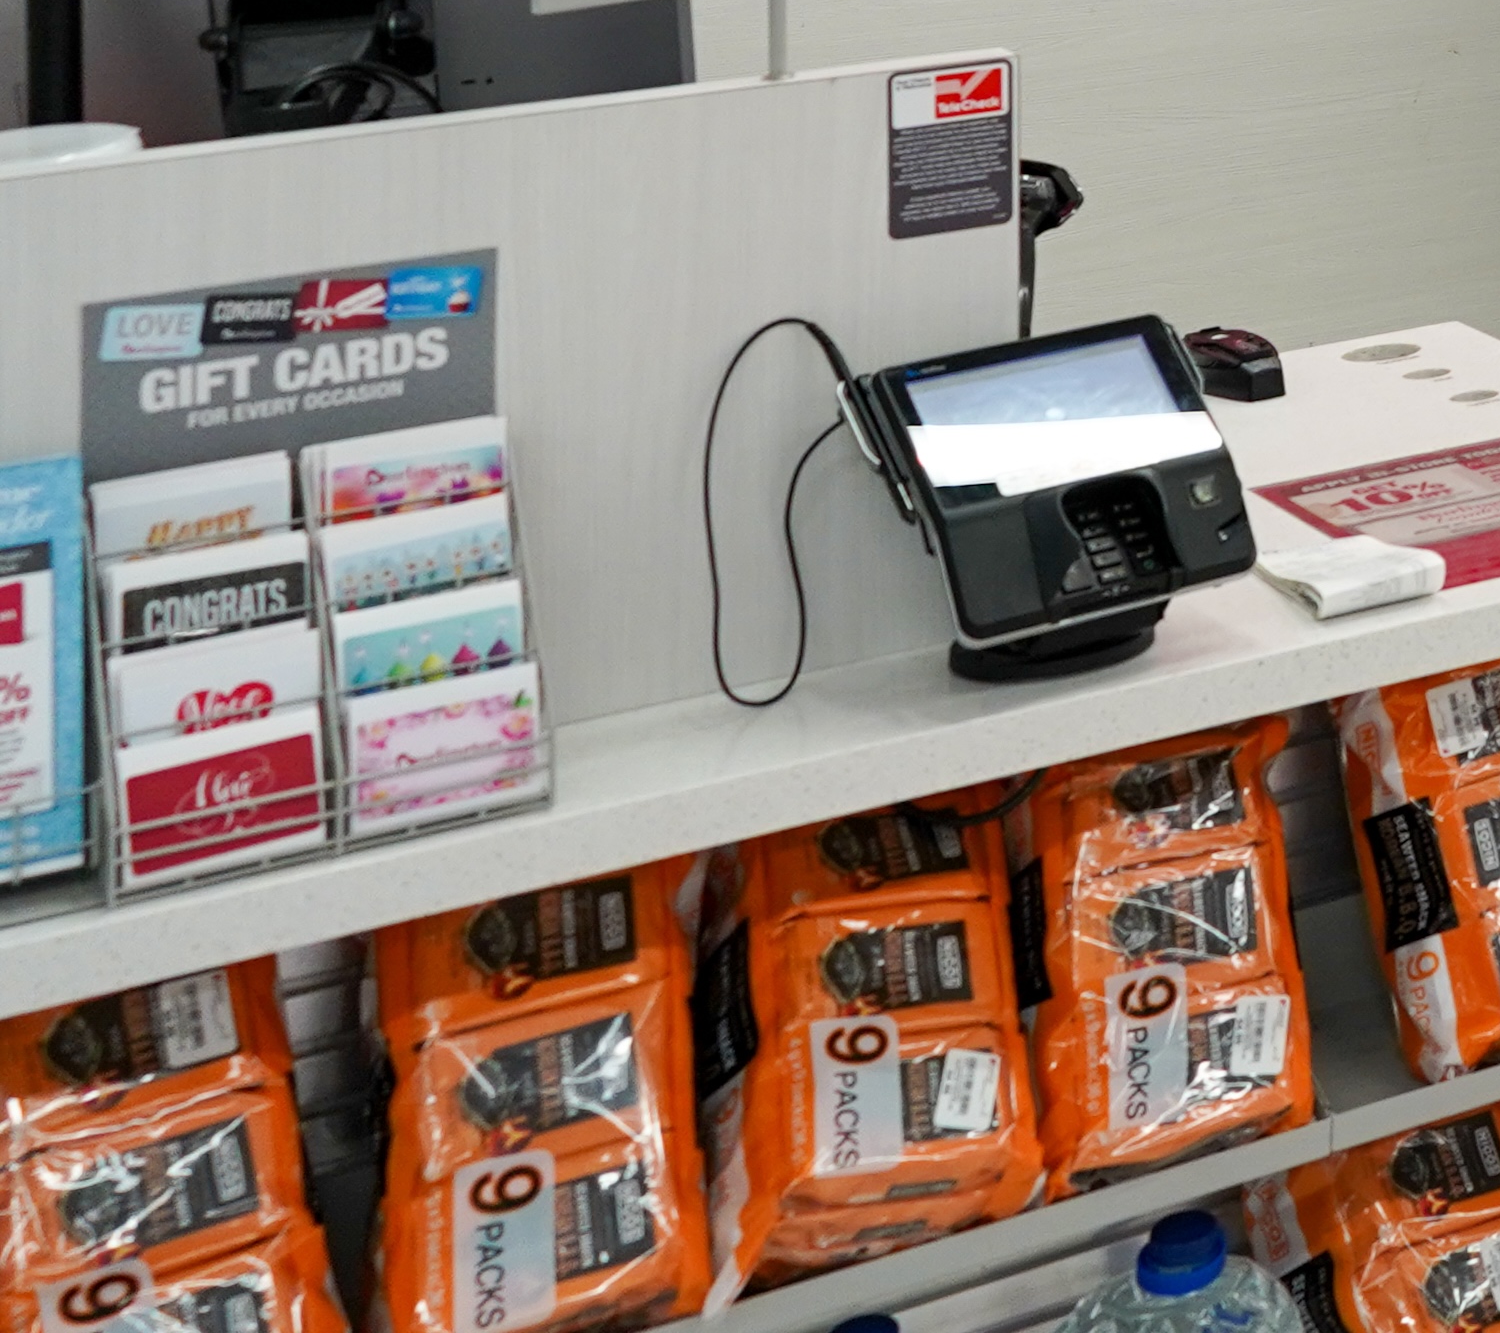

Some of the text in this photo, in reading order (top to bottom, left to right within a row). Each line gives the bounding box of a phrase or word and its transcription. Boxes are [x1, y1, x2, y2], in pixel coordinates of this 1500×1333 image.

[117, 310, 195, 343] LOVE
[138, 327, 451, 414] GIFT CARDS
[186, 379, 403, 431] FOR EVERY OCCASION
[143, 579, 287, 636] CONGRATS
[1116, 974, 1177, 1120] 9 PACKS
[824, 1024, 889, 1170] 9 PACKS
[468, 1164, 544, 1328] 9 PACKS
[56, 1273, 140, 1327] 9
